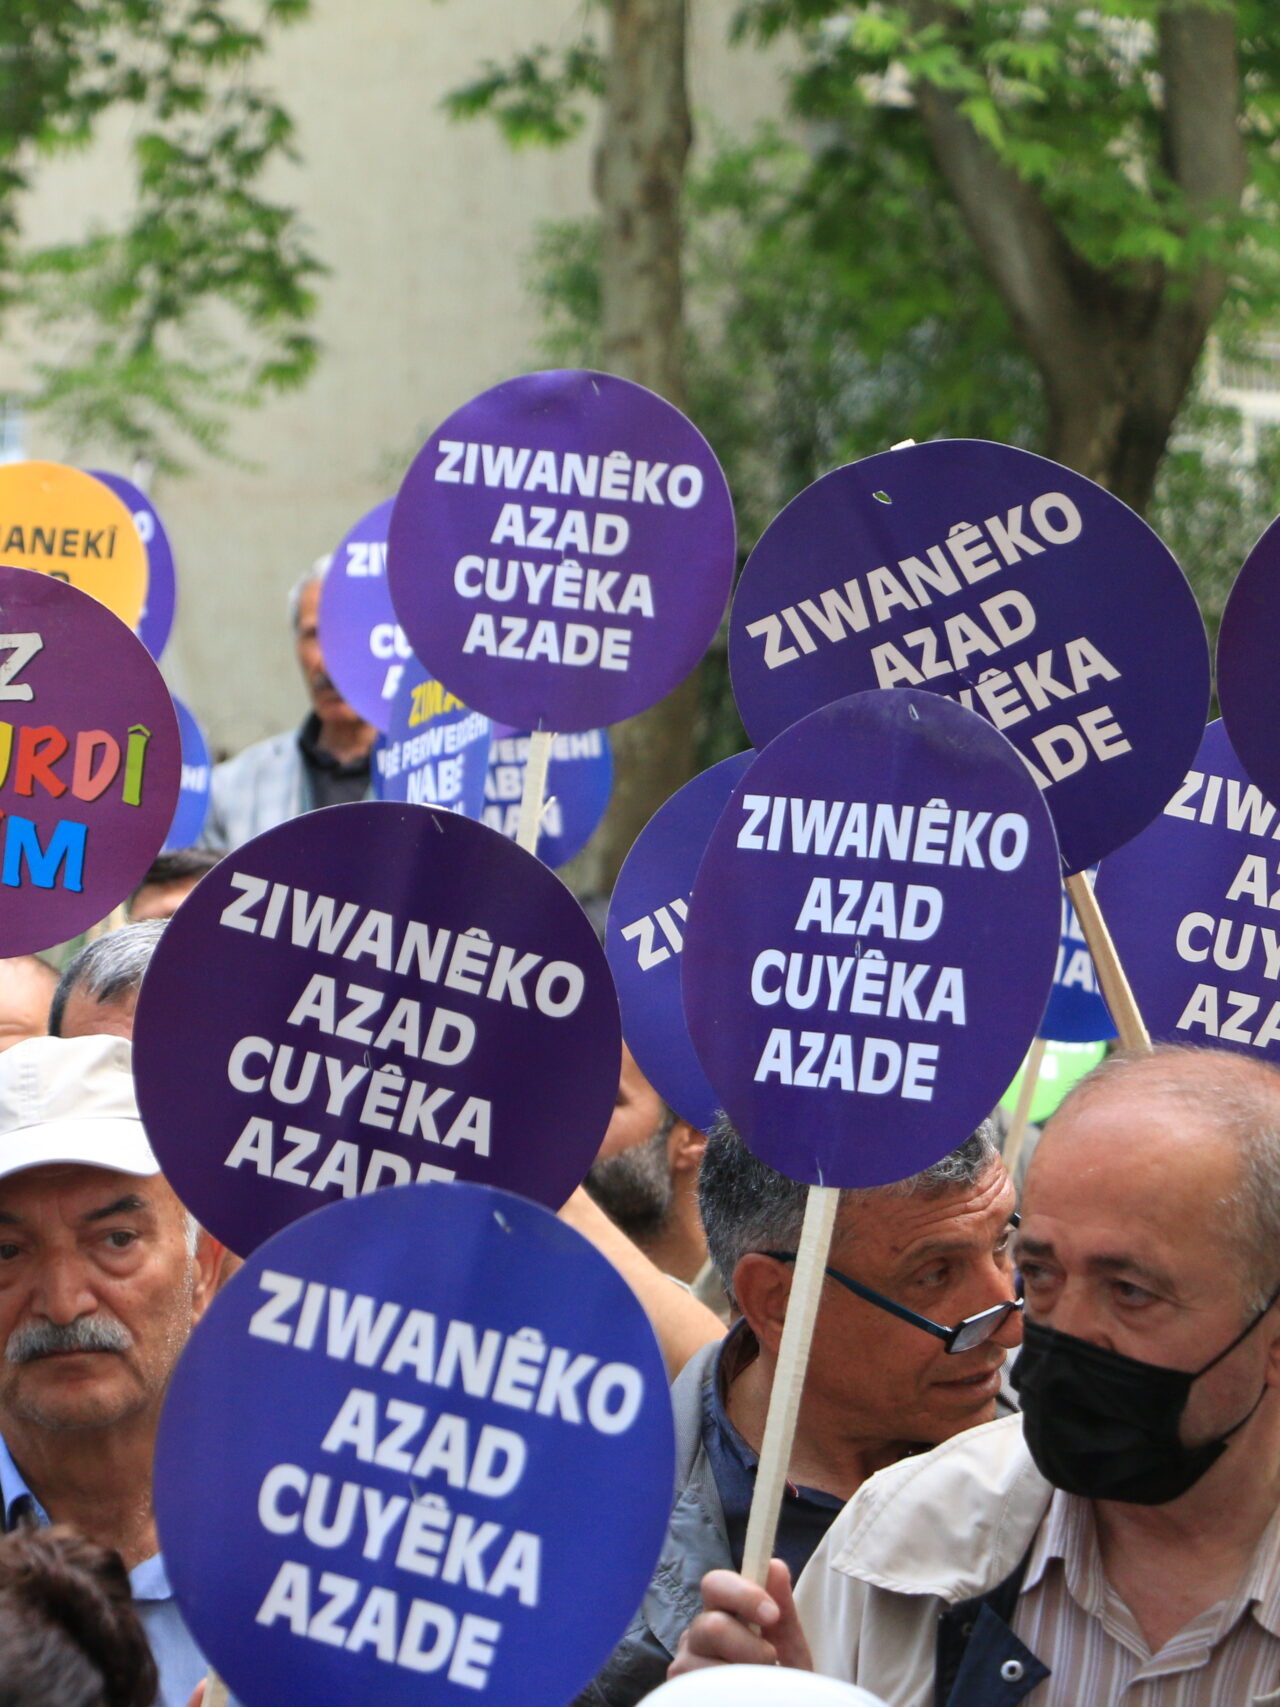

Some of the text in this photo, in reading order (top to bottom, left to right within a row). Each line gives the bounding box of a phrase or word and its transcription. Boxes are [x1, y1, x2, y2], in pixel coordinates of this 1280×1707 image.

[434, 439, 704, 509] ZIWANÊKO
[490, 503, 630, 556] AZAD
[453, 554, 655, 619] CUYÊKA
[746, 492, 1083, 669] ZIWANÊKO
[462, 612, 632, 672] AZADE
[871, 590, 1037, 694] AZAD
[736, 794, 1030, 872] ZIWANÊKO
[220, 871, 585, 1018] ZIWANÊKO
[794, 877, 944, 941] AZAD
[1176, 911, 1280, 981] CUY
[287, 973, 476, 1066] AZAD
[750, 948, 967, 1026] CUYÊKA
[227, 1035, 492, 1157] CUYÊKA
[753, 1028, 940, 1102] AZADE
[247, 1269, 644, 1436] ZIWANÊKO
[320, 1388, 528, 1498] AZAD
[257, 1463, 541, 1607] CUYÊKA
[255, 1561, 502, 1690] AZADE
